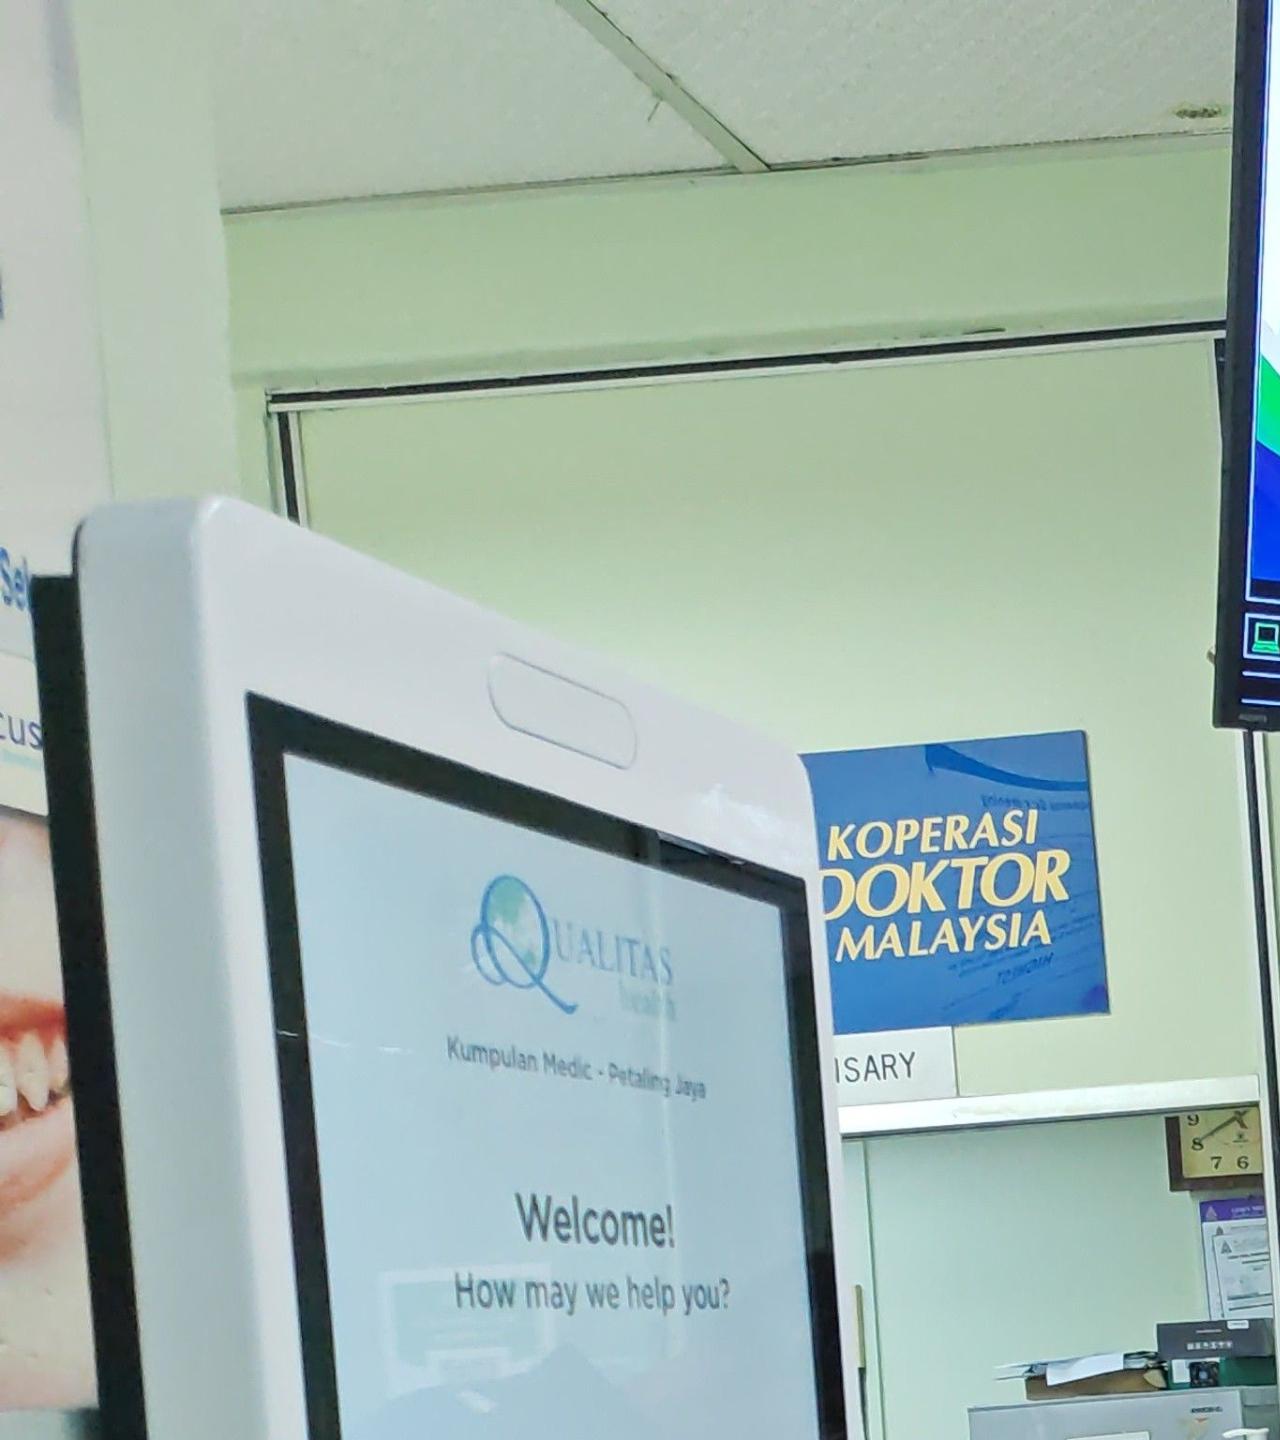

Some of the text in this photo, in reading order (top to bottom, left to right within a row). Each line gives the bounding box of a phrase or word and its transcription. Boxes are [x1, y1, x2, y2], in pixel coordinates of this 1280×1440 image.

[827, 808, 1038, 861] KOPERASI
[818, 849, 1071, 921] DOKTOR
[470, 874, 674, 1015] QUALITAS
[835, 909, 1052, 962] MALAYSIA
[446, 1035, 538, 1072] Kumpulan
[543, 1053, 593, 1081] Medic
[608, 1062, 671, 1098] Petaling
[675, 1073, 707, 1102] Jaya
[1191, 1137, 1204, 1151] 8
[1211, 1156, 1249, 1170] 7 6
[514, 1192, 675, 1249] Welcome!
[455, 1272, 730, 1317] How may we help you?
